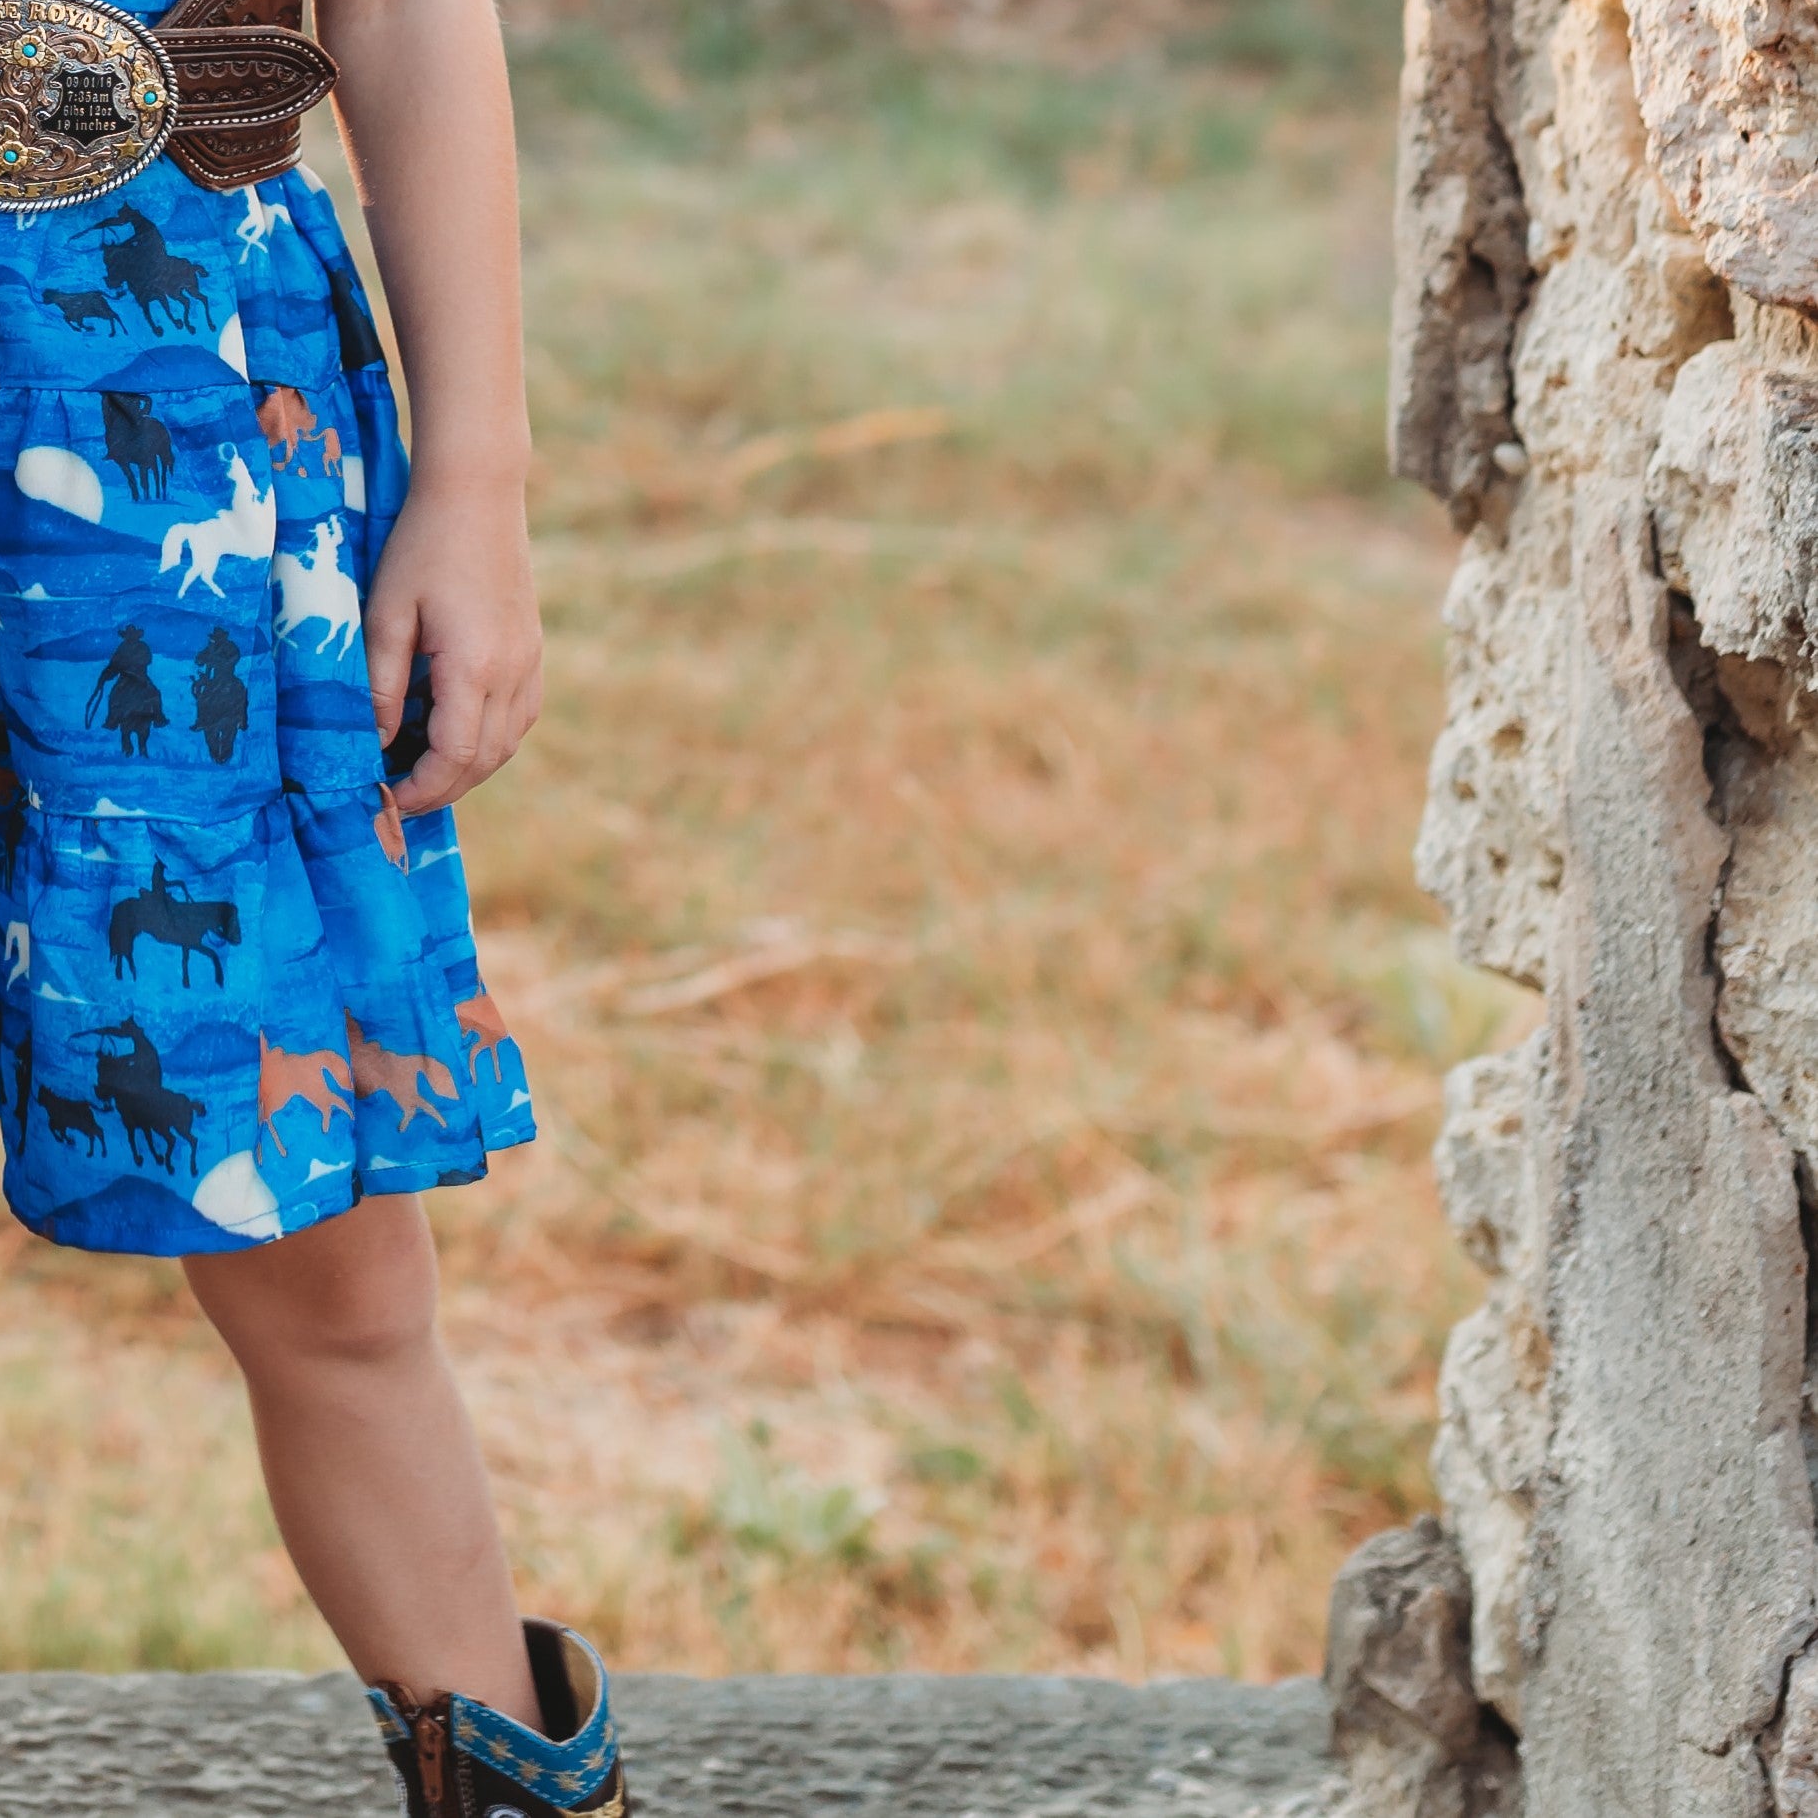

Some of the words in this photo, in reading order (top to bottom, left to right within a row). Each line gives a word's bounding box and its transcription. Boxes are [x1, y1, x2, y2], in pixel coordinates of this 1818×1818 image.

[29, 1, 110, 37] ROYAL
[66, 76, 112, 88] 0901/18
[67, 90, 109, 103] 7:35am
[63, 104, 85, 117] 6lbs
[89, 104, 112, 117] 12oz
[75, 118, 117, 131] inches
